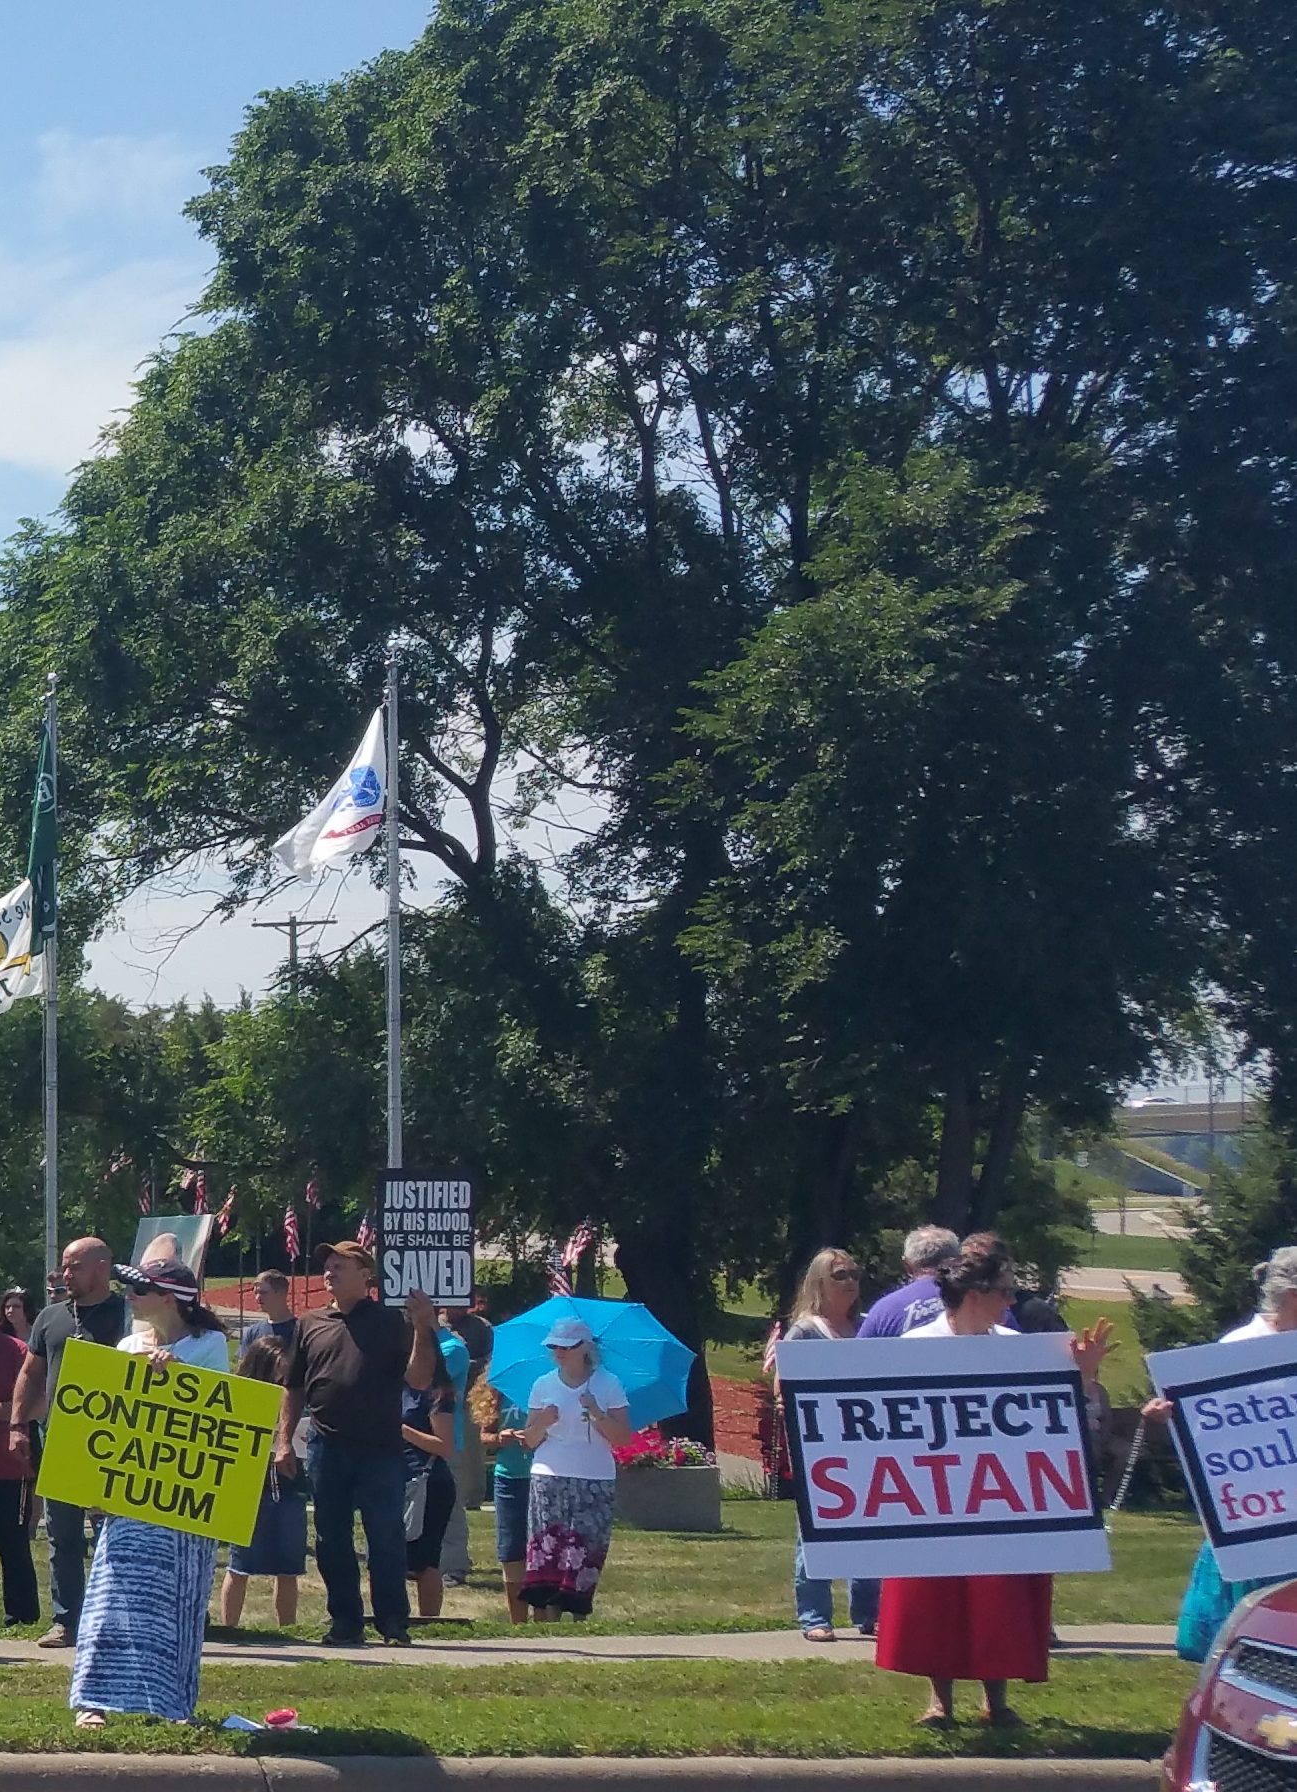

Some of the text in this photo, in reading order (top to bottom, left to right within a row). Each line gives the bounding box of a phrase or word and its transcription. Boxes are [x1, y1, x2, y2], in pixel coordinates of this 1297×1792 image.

[384, 1181, 471, 1209] JUSTIFIED
[384, 1212, 472, 1232] BY HIS BLOOD,
[384, 1234, 470, 1246] WE SHALL BE
[383, 1250, 471, 1296] SAVED
[124, 1360, 233, 1413] IPSA
[57, 1383, 272, 1457] CONTERET
[798, 1391, 1072, 1450] I REJECT
[1194, 1394, 1297, 1430] Sata
[88, 1430, 235, 1486] CAPUT
[98, 1466, 215, 1523] TUUM
[811, 1450, 1089, 1519] SATAN
[1221, 1483, 1286, 1520] for
